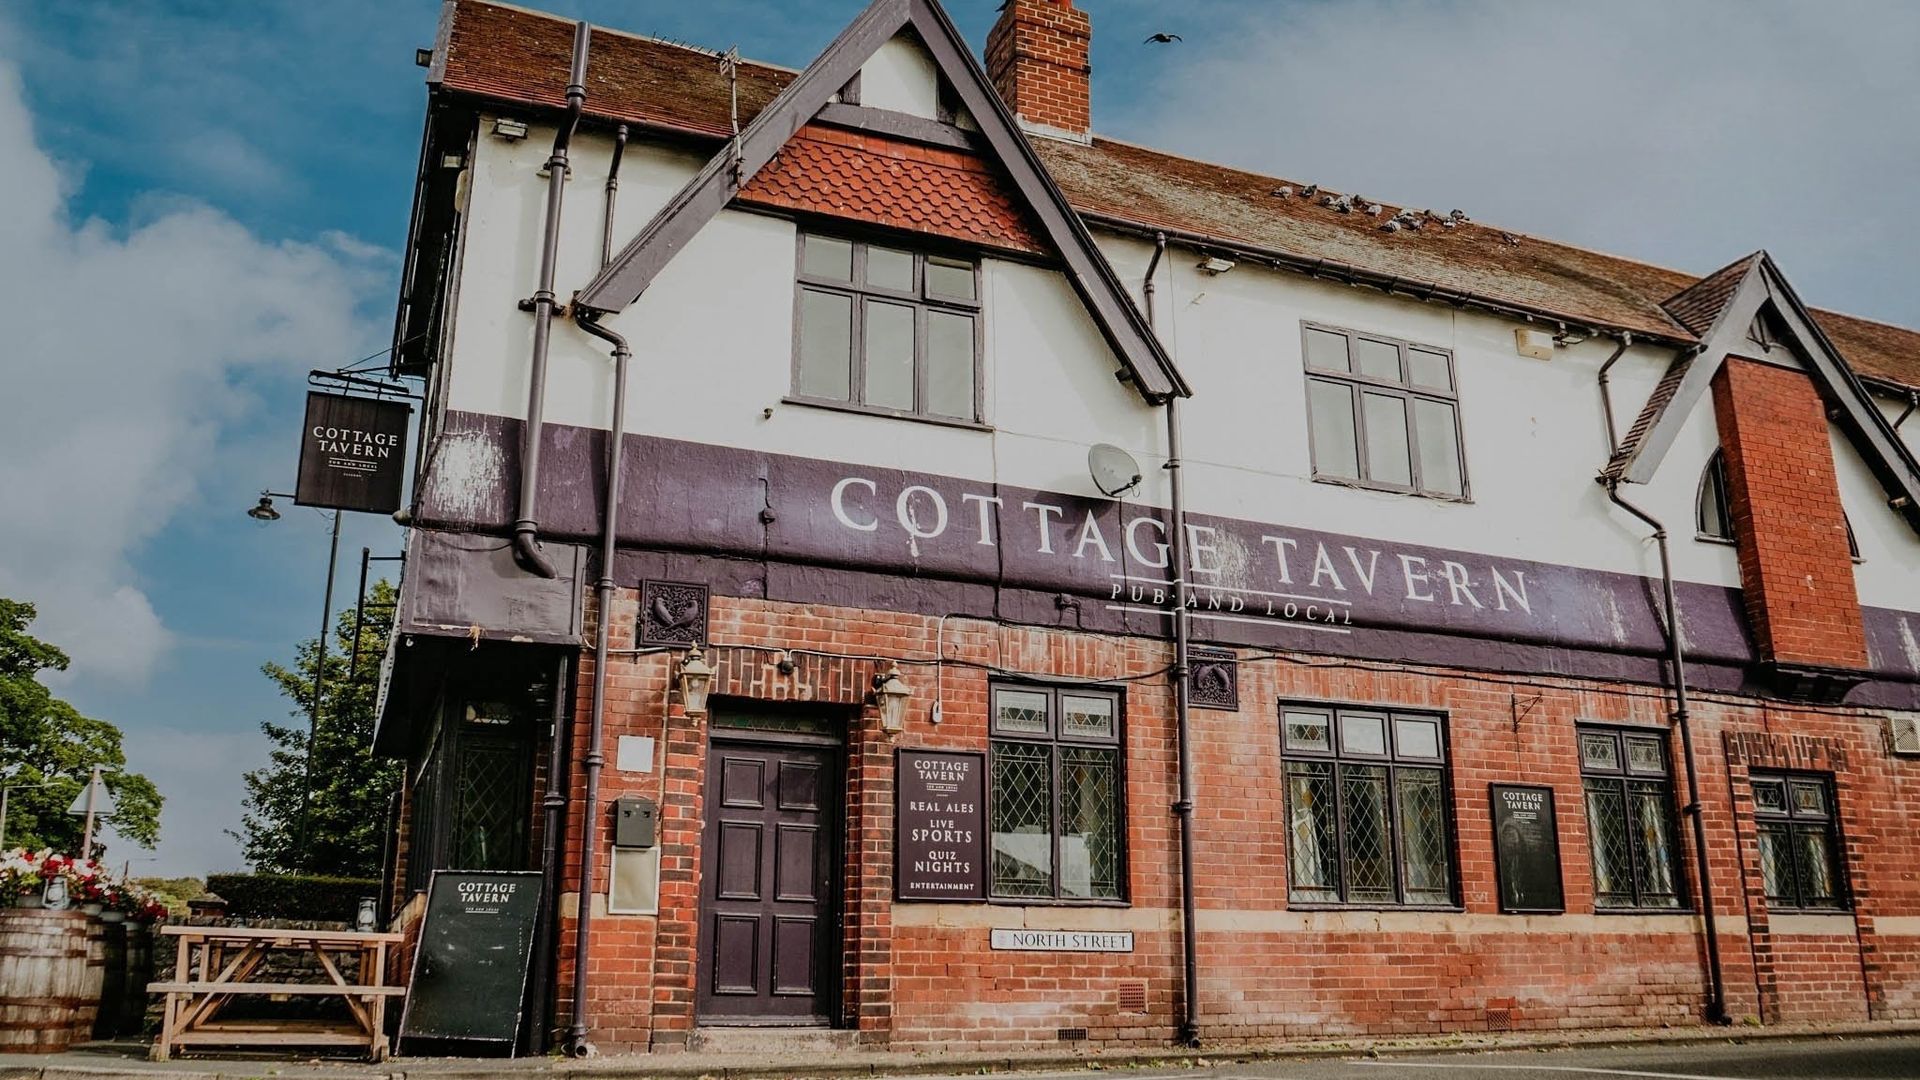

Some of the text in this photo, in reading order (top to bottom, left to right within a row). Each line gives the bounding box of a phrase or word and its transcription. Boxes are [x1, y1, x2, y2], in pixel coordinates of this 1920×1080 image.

[313, 426, 398, 446] COTTAGE
[318, 440, 390, 458] TAVERN
[830, 477, 1533, 617] COTTAGE TAVERN
[1110, 583, 1353, 626] PUB AND LOCAL
[914, 760, 969, 772] COTTAGE
[918, 770, 965, 781] TAVERN
[1502, 792, 1543, 802] COTTAGE
[910, 801, 974, 813] REAL ALES
[1506, 800, 1541, 810] TAVERN
[930, 819, 955, 829] LIVE
[911, 829, 972, 843] SPORTS
[928, 850, 957, 861] QUIZ
[914, 861, 970, 874] NIGHTS
[458, 883, 517, 893] COTTAGE
[910, 882, 975, 891] ENTERTAINMENT
[461, 892, 510, 903] TAVERN
[1013, 933, 1128, 949] NORTH STREET
